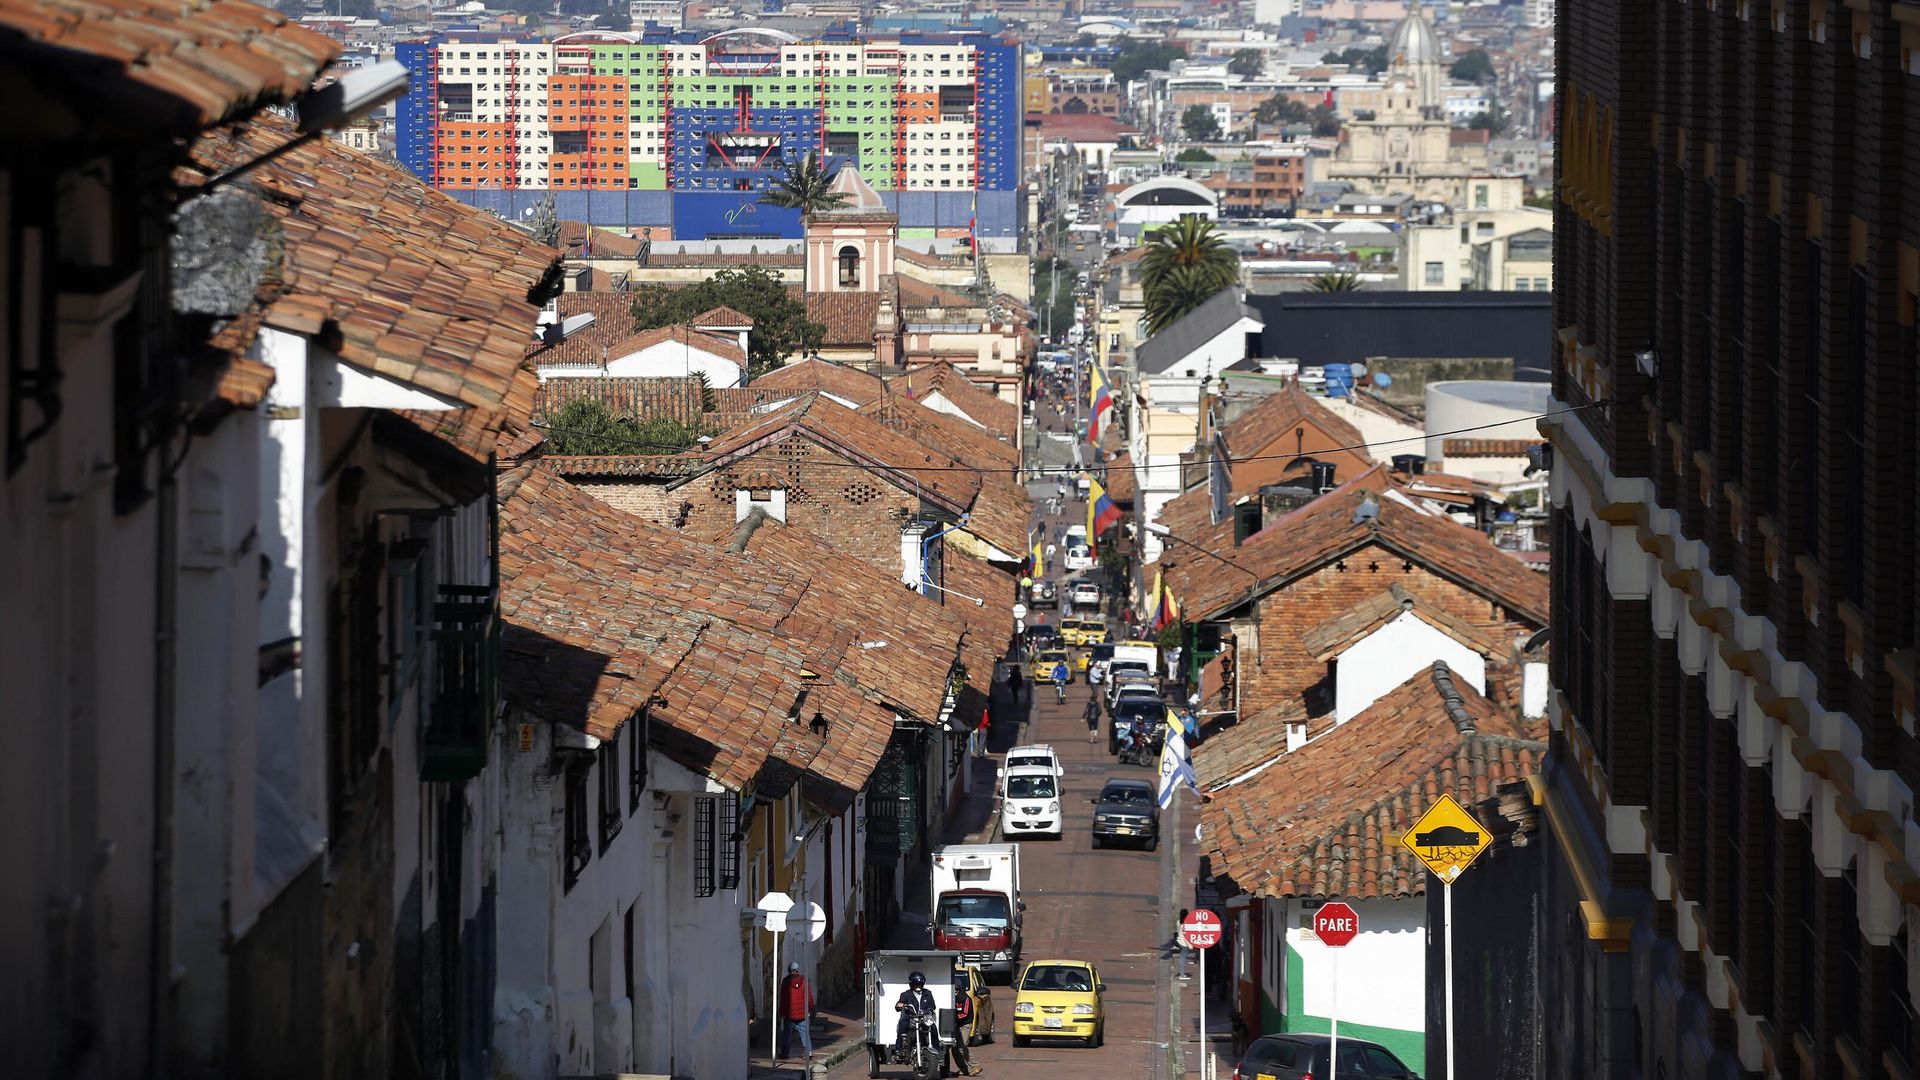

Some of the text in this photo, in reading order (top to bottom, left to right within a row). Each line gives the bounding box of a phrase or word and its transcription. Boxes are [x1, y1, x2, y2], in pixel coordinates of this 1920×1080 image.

[1195, 911, 1208, 921] NO
[1319, 918, 1353, 932] PARE
[1190, 934, 1215, 944] PASE
